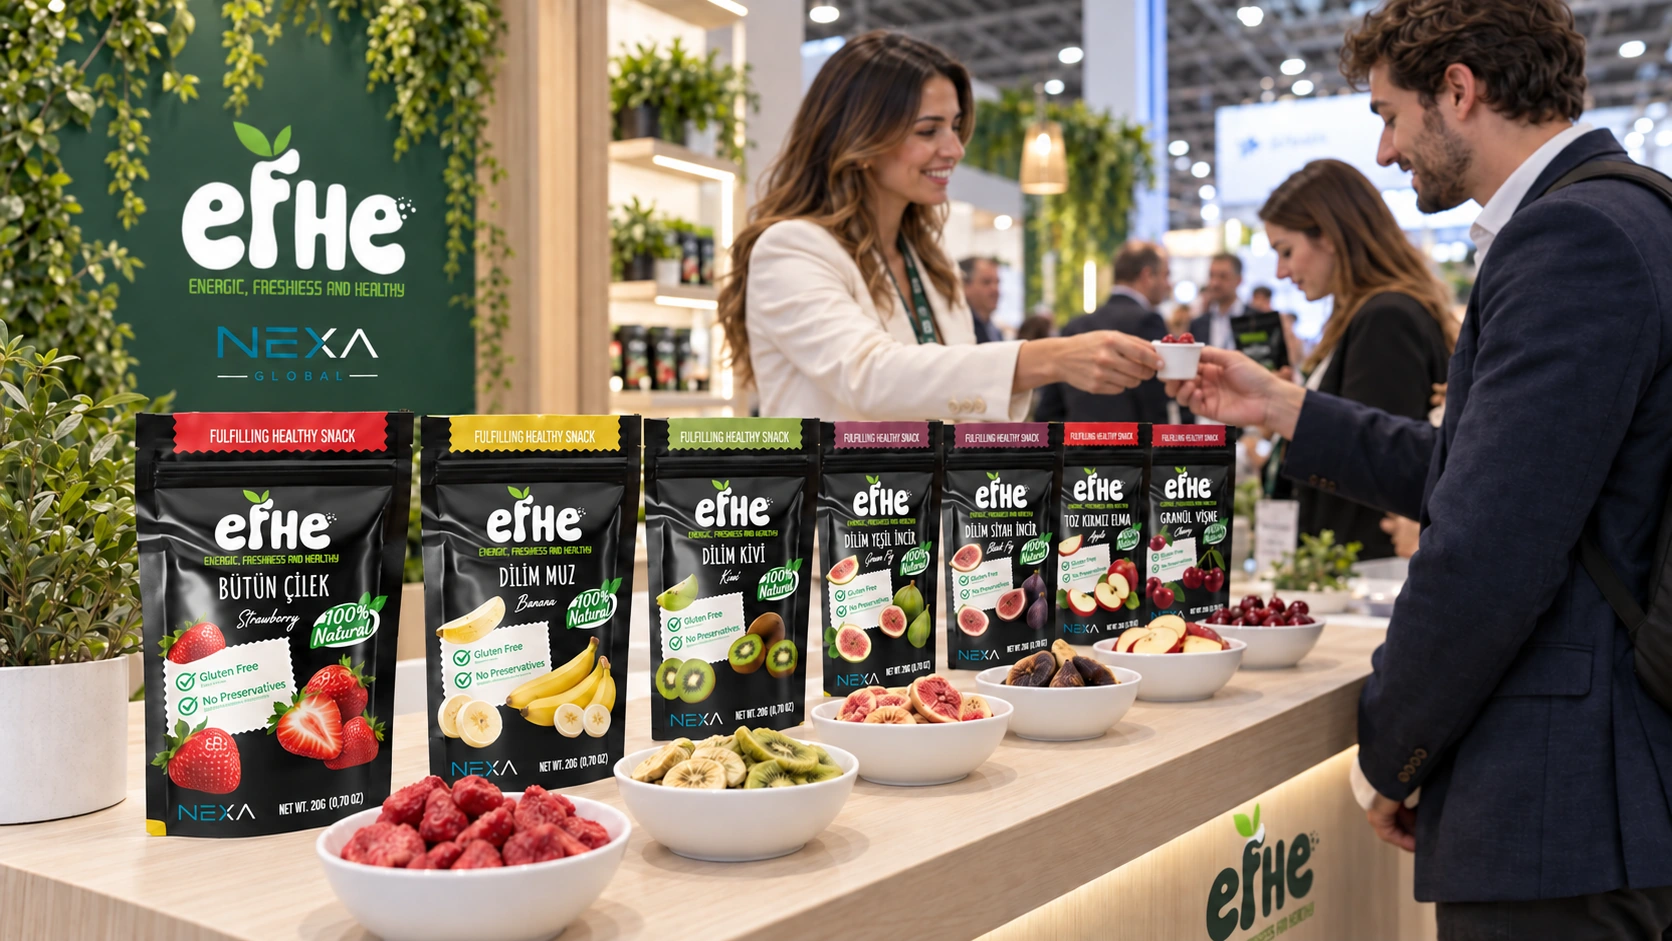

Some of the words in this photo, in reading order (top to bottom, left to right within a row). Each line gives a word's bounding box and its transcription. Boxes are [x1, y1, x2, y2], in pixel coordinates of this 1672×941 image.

[188, 278, 249, 297] ENERGIC,
[326, 280, 351, 297] AND
[354, 282, 405, 298] HEALTHY
[217, 326, 379, 359] NEXA
[254, 370, 343, 382] GLOBAL
[209, 428, 269, 444] FULFILLING
[272, 428, 318, 443] HEALTHY
[320, 428, 356, 443] SNACK
[474, 429, 524, 444] FULFILLING
[525, 429, 564, 444] HEALTHY
[565, 429, 596, 443] SNACK
[680, 430, 724, 443] FULFILLING
[725, 430, 761, 443] HEALTHY
[762, 430, 790, 443] SNACK
[1063, 514, 1080, 528] TOZ
[1111, 513, 1132, 527] ELMA
[1160, 509, 1192, 524] GRANÜL
[1195, 509, 1218, 525] VİŞNE
[844, 531, 869, 549] DİLİM
[871, 529, 892, 550] YEŞİL
[894, 528, 917, 546] İNCİR
[965, 522, 989, 539] DİLİM
[990, 521, 1013, 538] SİYAH
[1015, 520, 1038, 537] İNCİR
[287, 554, 304, 564] AND
[304, 554, 340, 564] HEALTHY
[702, 544, 735, 566] DİLİM
[740, 542, 766, 565] KİVİ
[499, 562, 540, 588] DİLİM
[545, 564, 576, 586] MUZ
[766, 568, 793, 583] 100%
[218, 573, 277, 600] BÜTÜN
[284, 572, 330, 604] ÇİLEK
[759, 578, 794, 599] Natural
[514, 593, 557, 613] Banana
[575, 589, 611, 609] 100%
[236, 608, 300, 632] Strawberry
[324, 604, 370, 626] 100%
[568, 602, 612, 627] Natural
[683, 614, 707, 625] Gluten
[707, 611, 723, 620] Free
[313, 620, 373, 646] Natural
[685, 635, 696, 643] No
[697, 625, 741, 640] Preservatives
[1063, 623, 1100, 634] NEXA
[473, 647, 503, 659] Gluten
[504, 643, 524, 653] Free
[958, 649, 1000, 661] NEXA
[199, 667, 235, 682] Gluten
[236, 662, 259, 675] Free
[475, 671, 489, 680] No
[490, 660, 546, 677] Preservatives
[837, 672, 880, 687] NEXA
[202, 696, 218, 706] No
[220, 681, 287, 702] Preservatives
[669, 712, 724, 727] NEXA
[451, 760, 518, 777] NEXA
[539, 761, 552, 773] NET
[553, 759, 565, 771] WT.
[565, 757, 578, 770] 20G
[597, 752, 609, 765] OZ)
[178, 803, 256, 821] NEXA
[278, 803, 295, 816] NET
[295, 801, 309, 814] WT.
[310, 799, 326, 811] 20G
[328, 794, 350, 810] (0,70
[350, 792, 364, 805] OZ)
